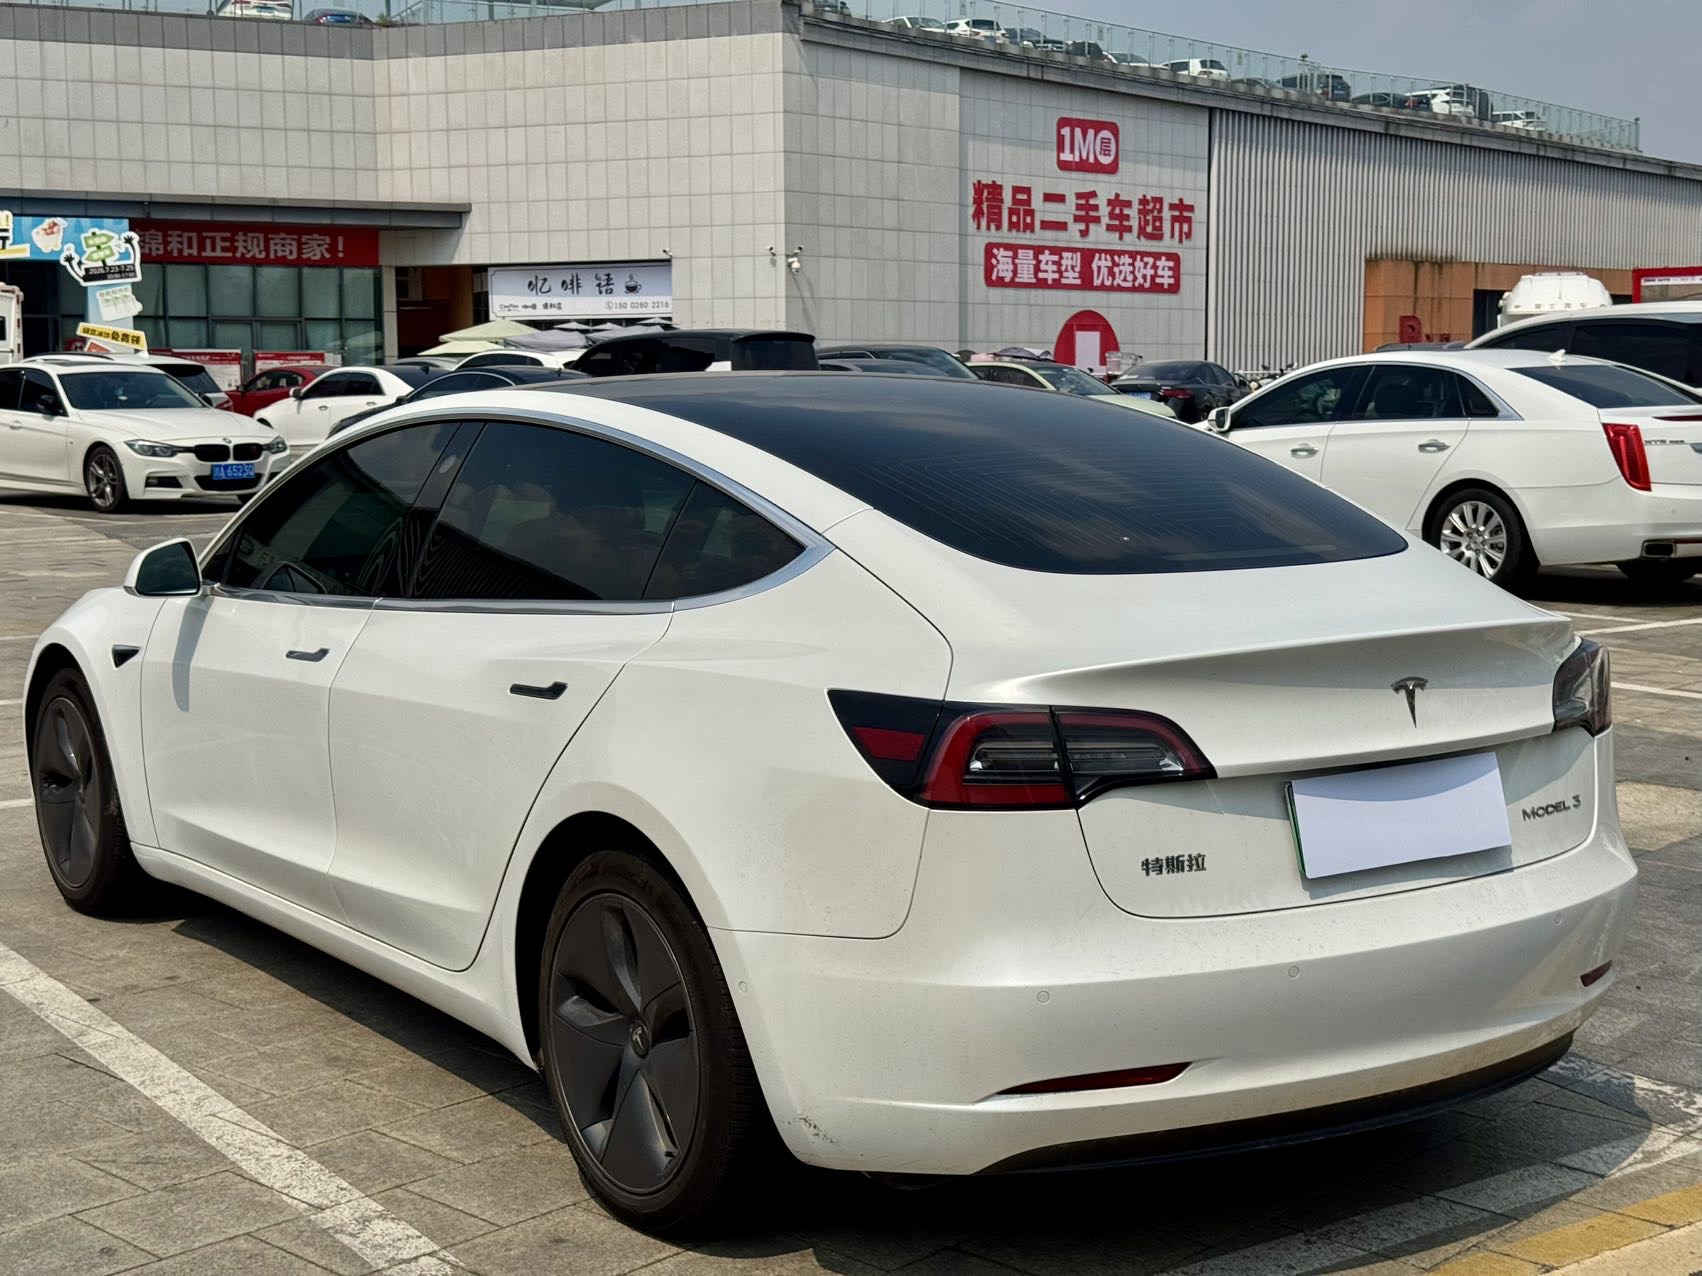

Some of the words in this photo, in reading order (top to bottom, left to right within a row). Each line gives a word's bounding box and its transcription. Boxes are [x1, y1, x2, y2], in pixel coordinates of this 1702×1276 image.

[971, 180, 1195, 244] 精品二手车超市
[990, 247, 1082, 285] 海量车型
[1091, 252, 1175, 289] 优选好车
[1521, 800, 1571, 821] MODEL
[1572, 794, 1581, 808] 3
[1141, 853, 1207, 877] 特斯拉
